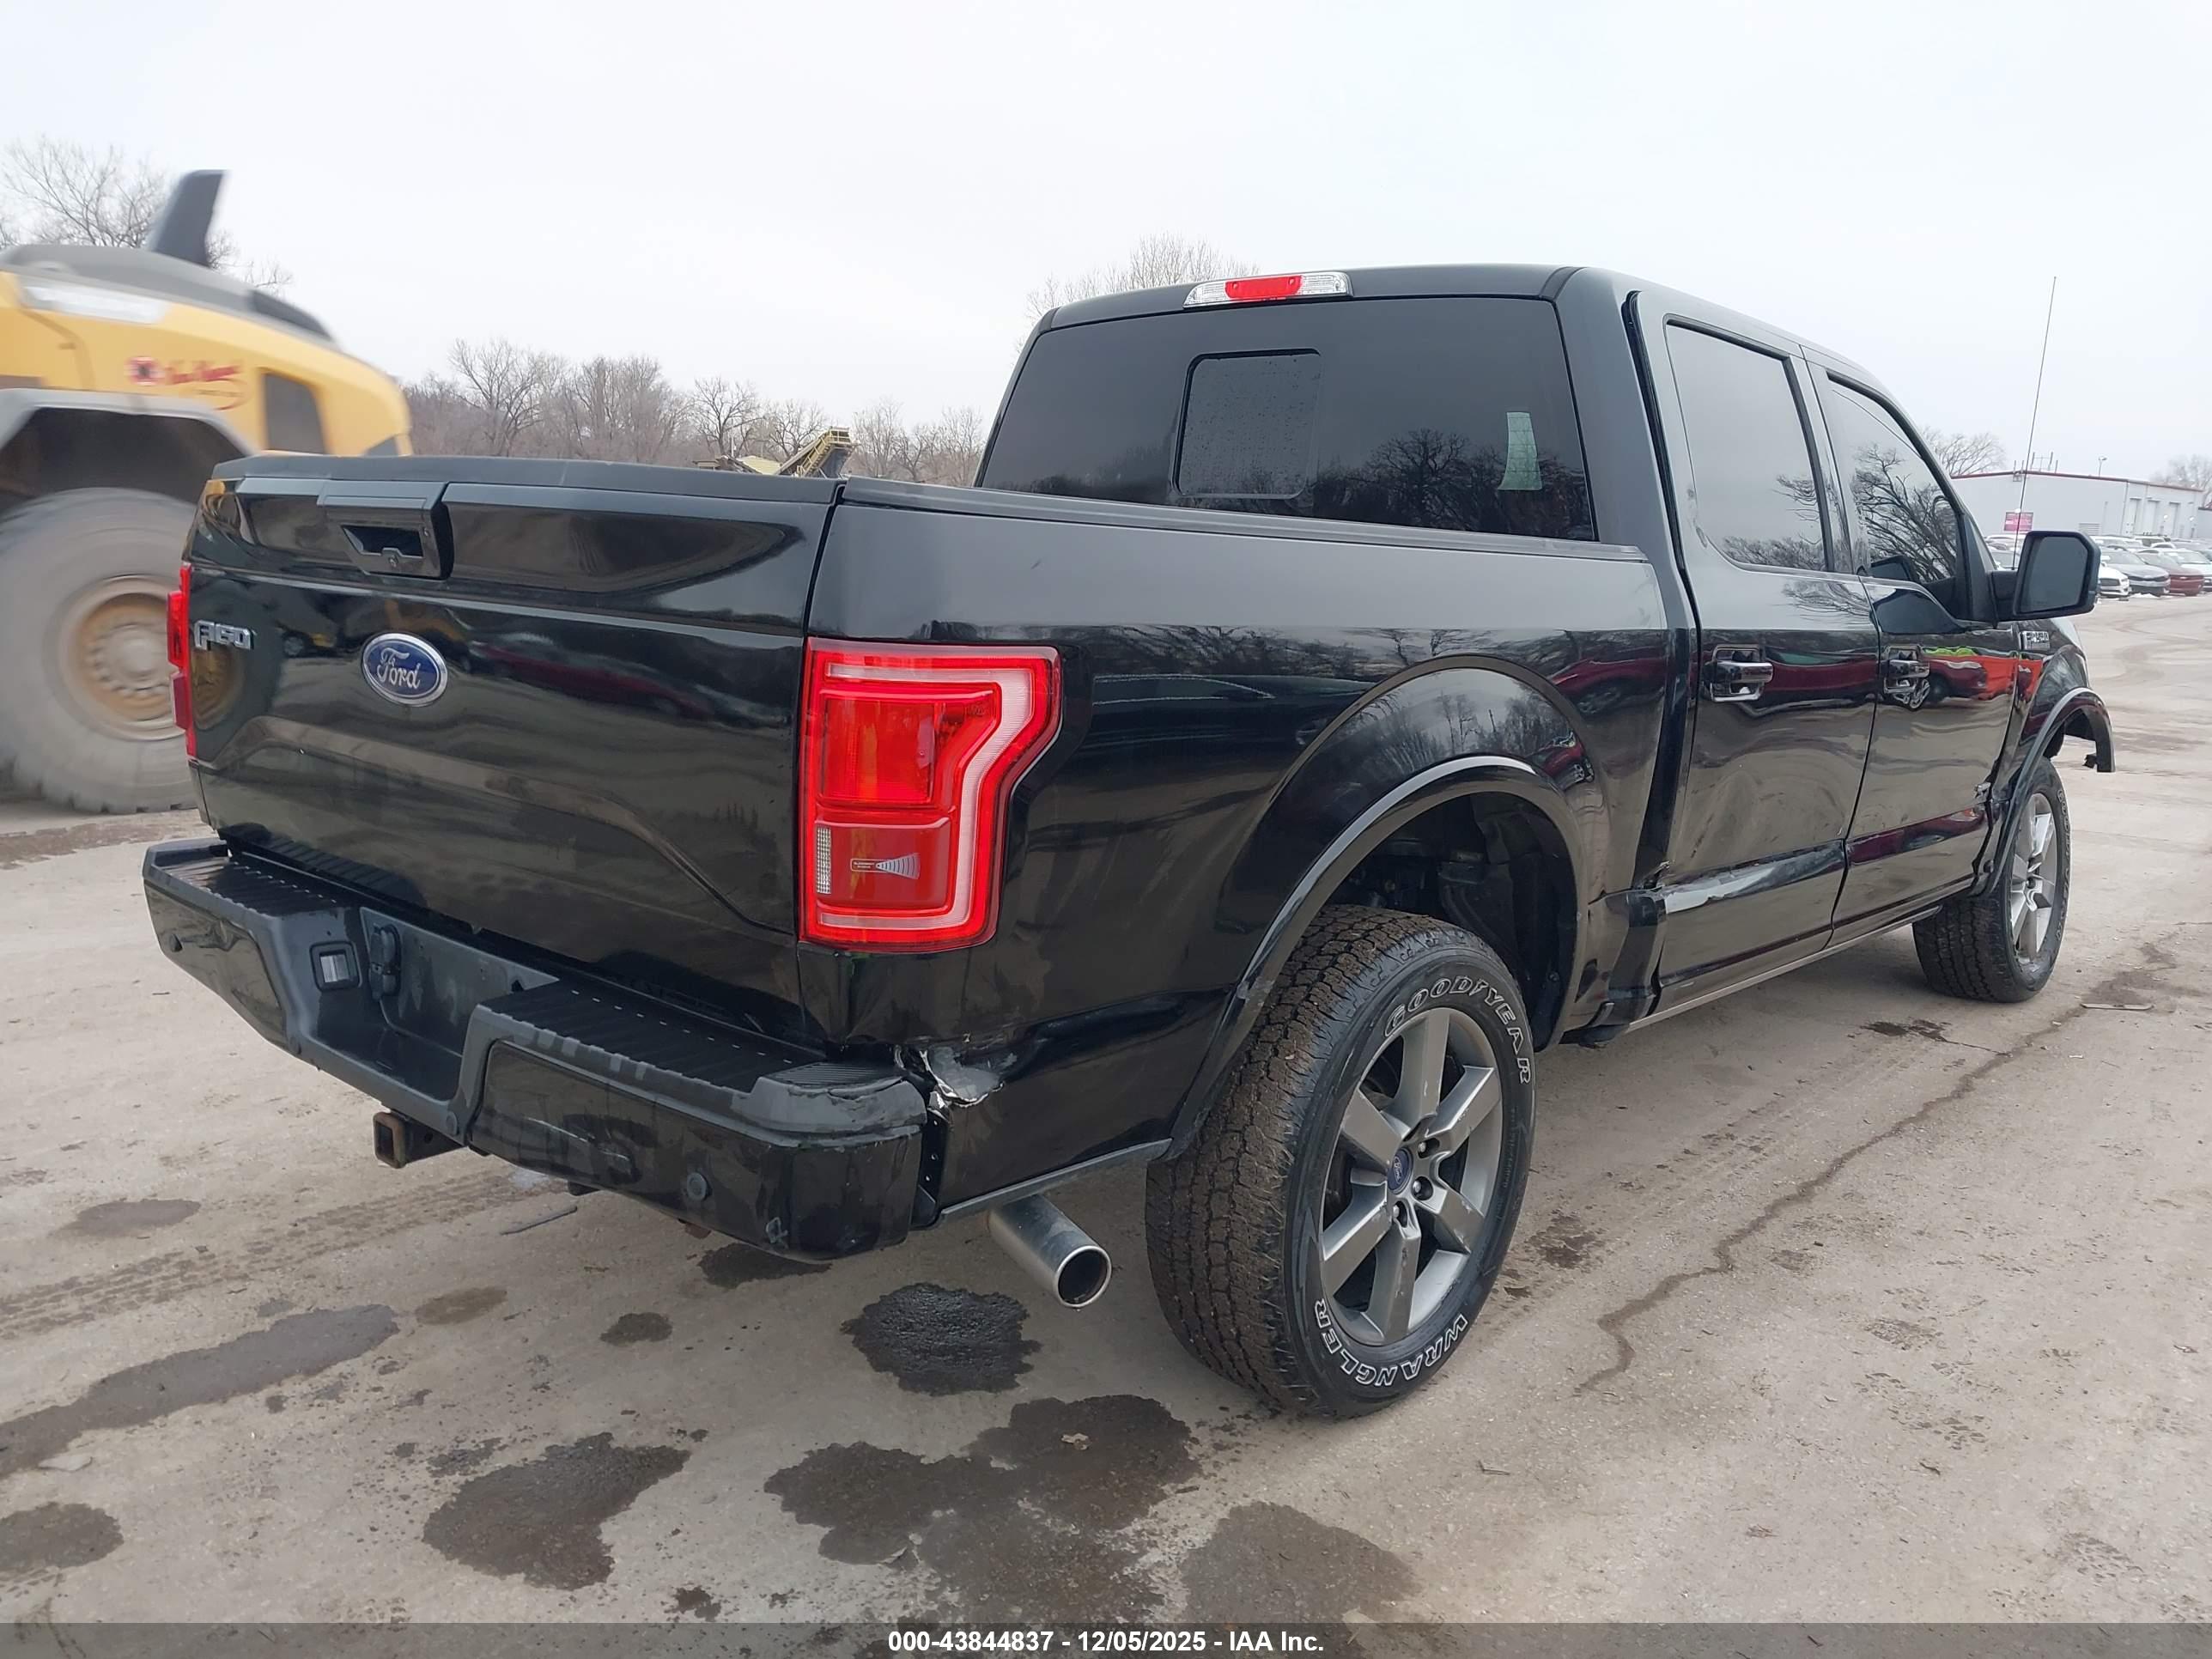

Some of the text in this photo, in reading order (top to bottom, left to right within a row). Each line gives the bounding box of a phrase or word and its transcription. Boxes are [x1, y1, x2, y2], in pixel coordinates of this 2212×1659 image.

[377, 647, 422, 689] Ford
[1384, 975, 1531, 1084] GOODYEAR
[1314, 1298, 1468, 1387] WRANGLER
